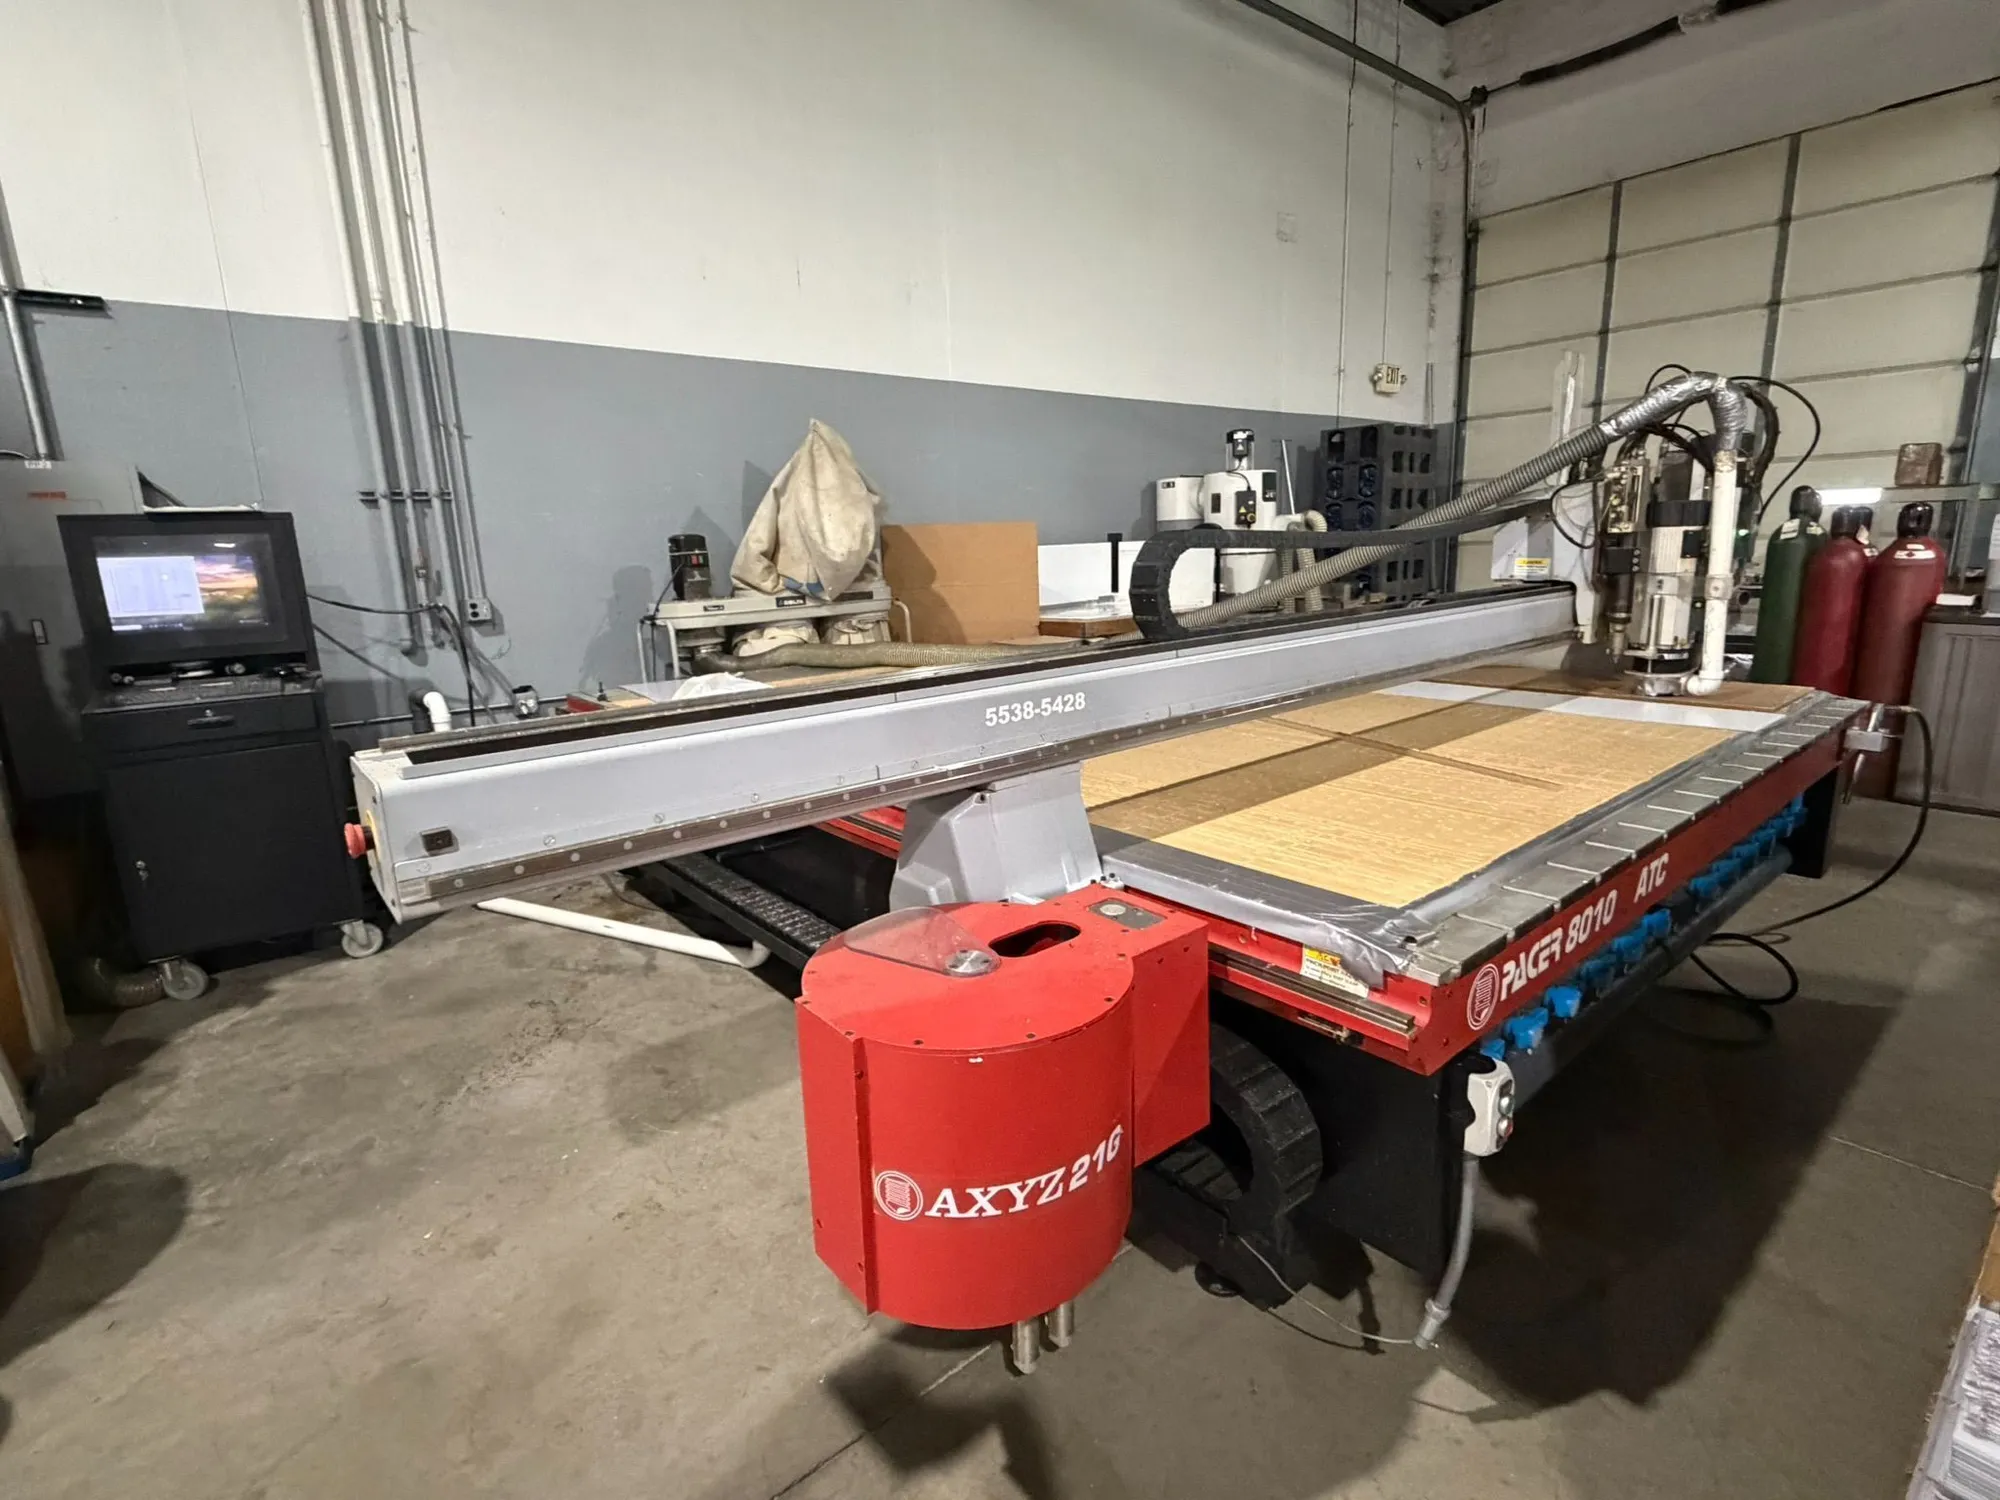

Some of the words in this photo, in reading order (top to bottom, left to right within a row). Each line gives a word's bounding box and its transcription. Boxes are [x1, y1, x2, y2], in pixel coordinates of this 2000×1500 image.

[1386, 366, 1400, 384] EXIT
[985, 692, 1086, 727] 5538-5428
[1501, 927, 1564, 1001] PACER
[1565, 889, 1618, 954] 8010
[1634, 852, 1669, 903] ATC
[925, 1166, 1066, 1218] AXYZ
